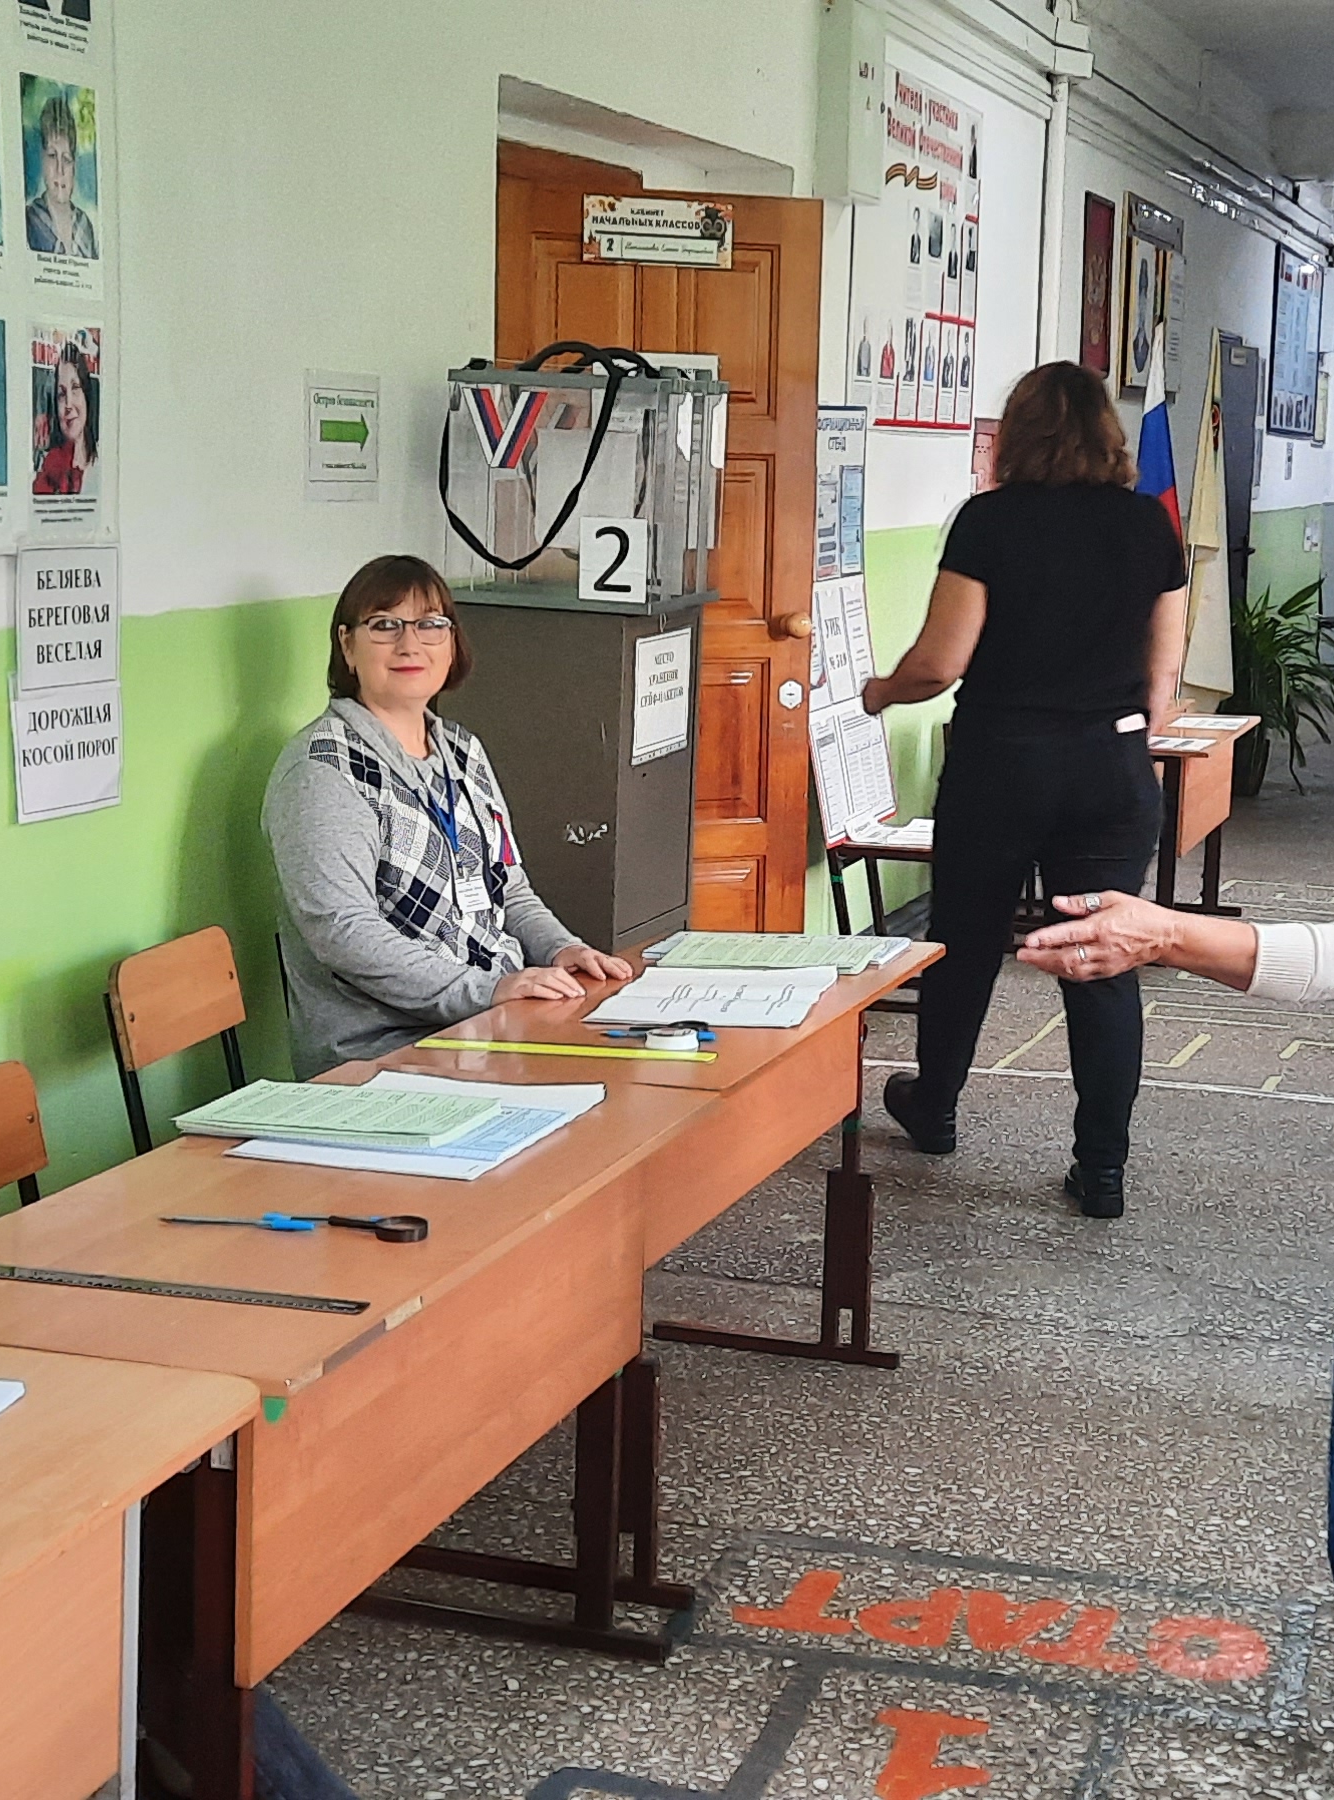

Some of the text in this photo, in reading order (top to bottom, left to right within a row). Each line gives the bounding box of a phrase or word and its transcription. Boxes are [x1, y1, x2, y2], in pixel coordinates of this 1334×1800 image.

[592, 215, 701, 231] НАЧАЛЬНЫХ КЛАССОВ
[594, 526, 631, 592] 2
[37, 568, 102, 590] БЕЛЯЕВА
[28, 604, 110, 628] БЕРЕГОВАЯ
[36, 639, 102, 665] ВЕСЕЛАЯ
[27, 703, 112, 735] ДОРОЖНАЯ
[22, 736, 118, 767] КОСОЙ ПОРОГ
